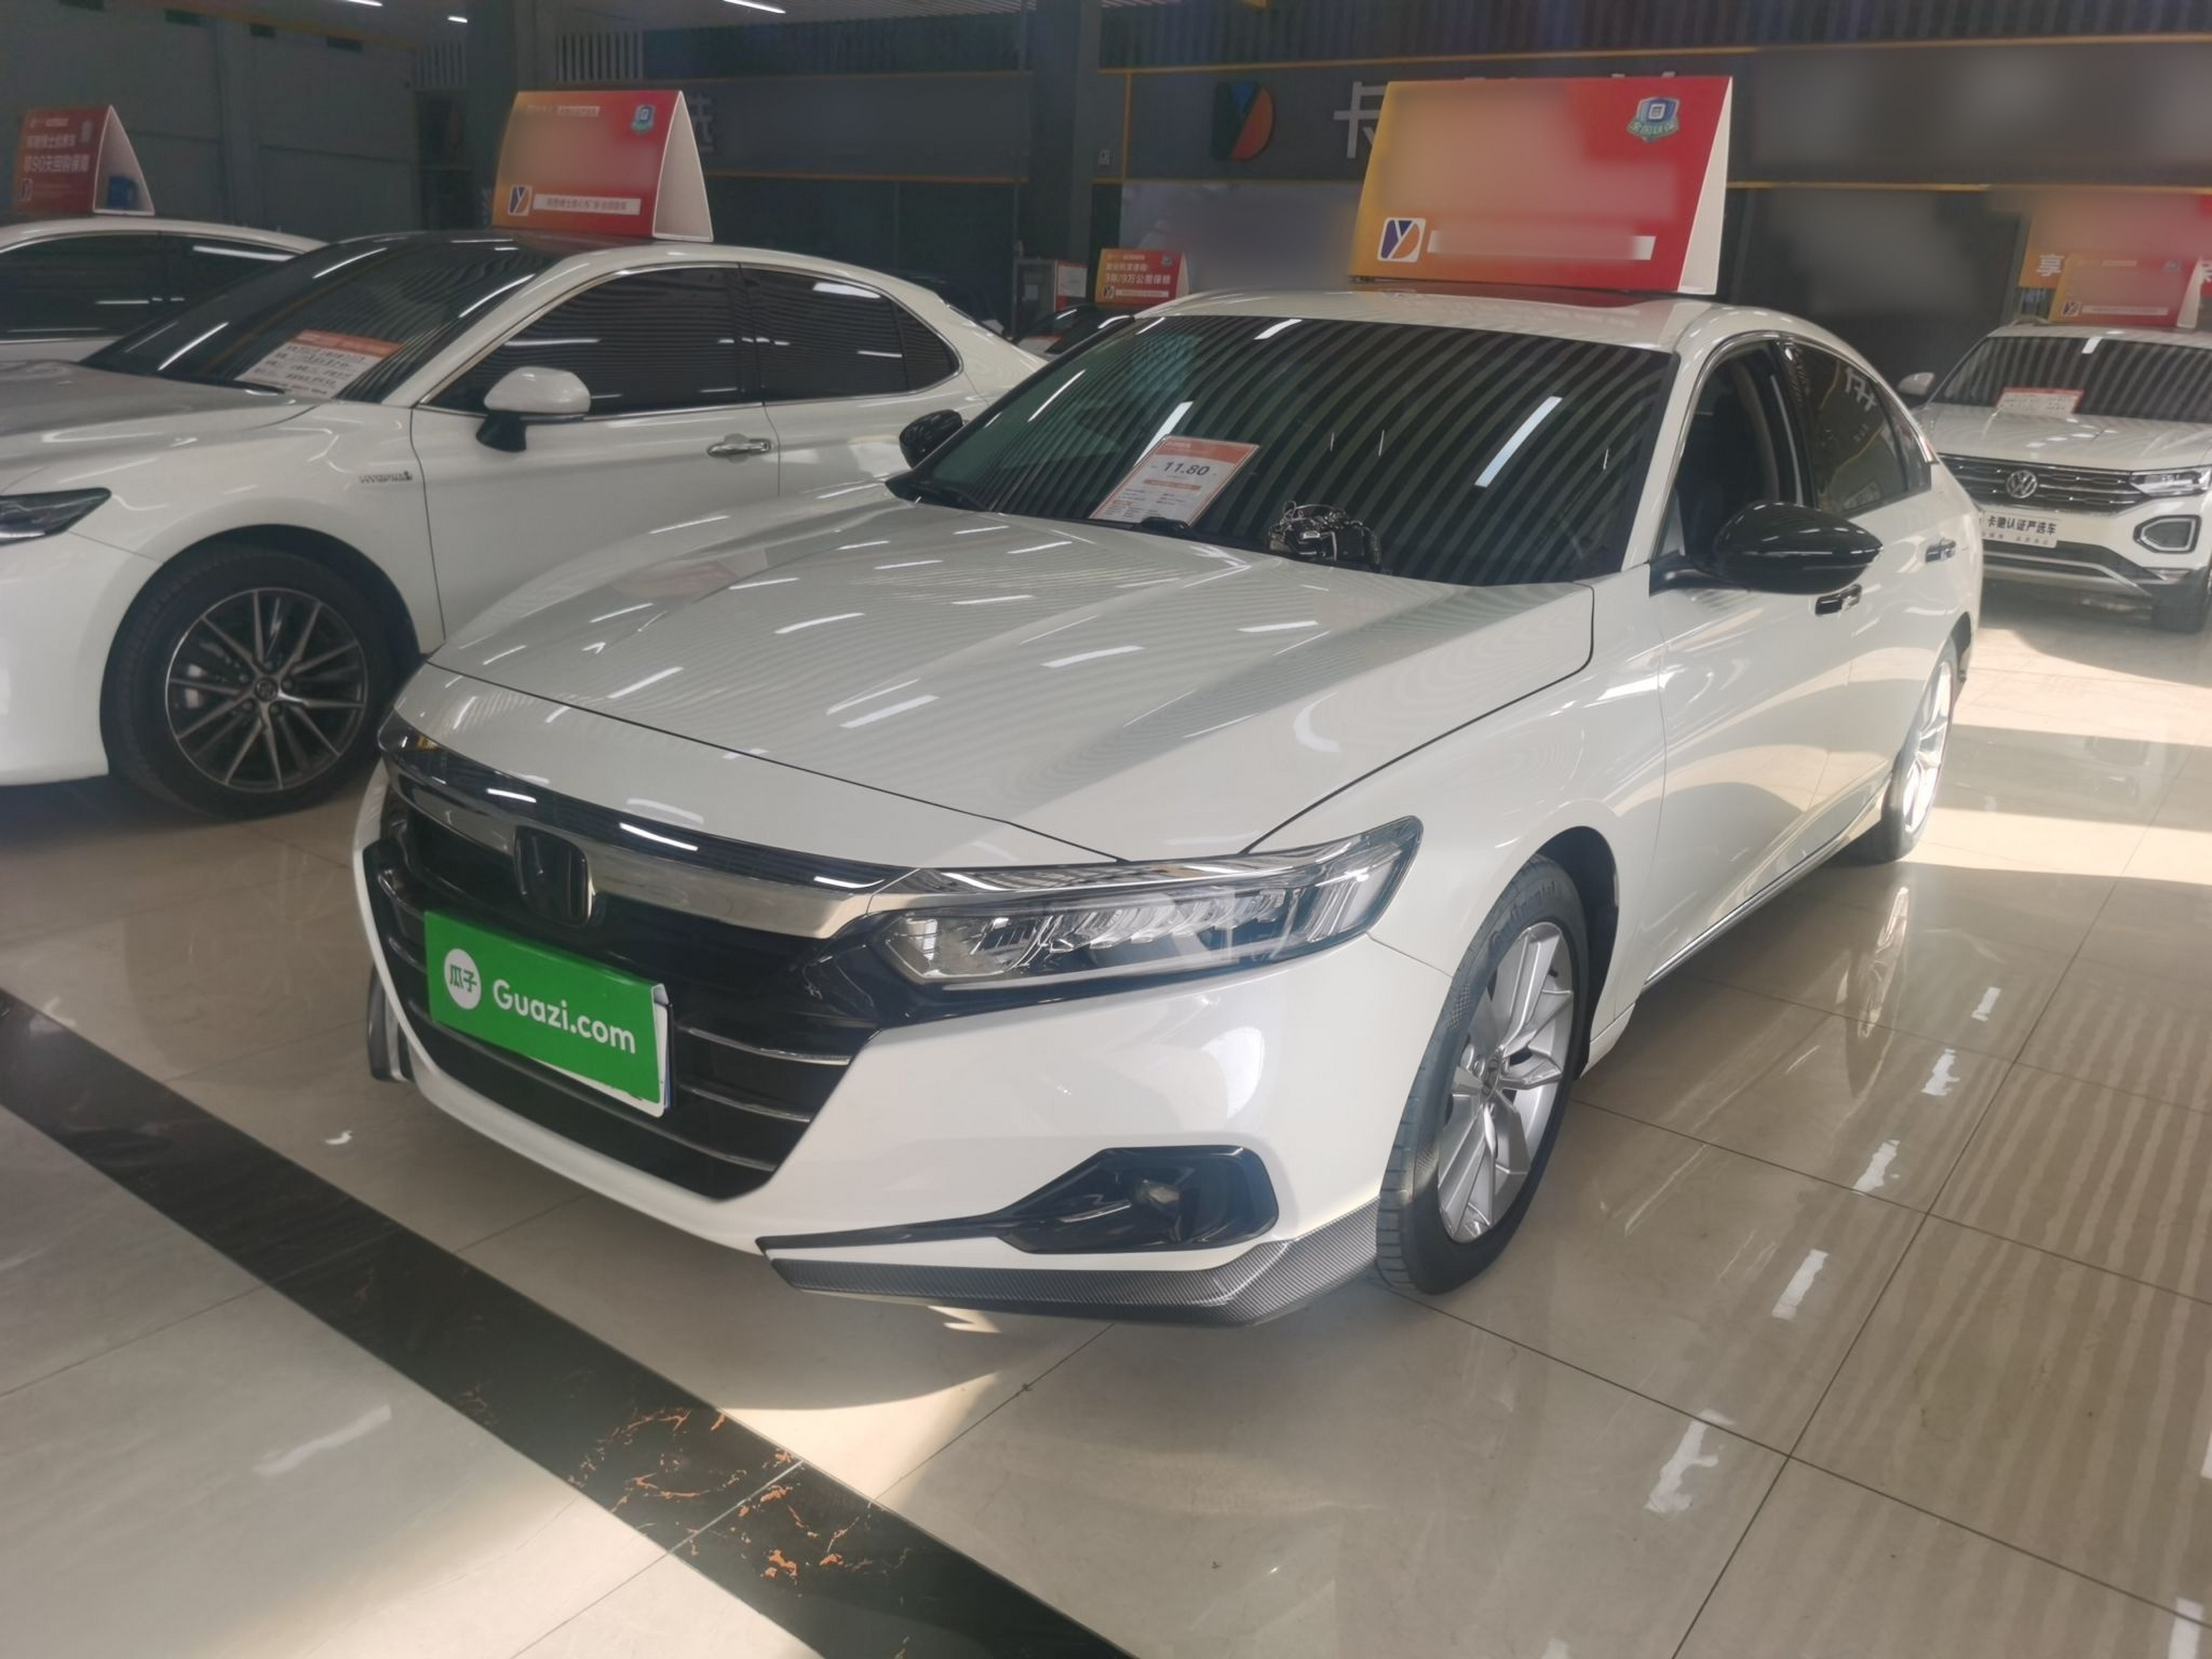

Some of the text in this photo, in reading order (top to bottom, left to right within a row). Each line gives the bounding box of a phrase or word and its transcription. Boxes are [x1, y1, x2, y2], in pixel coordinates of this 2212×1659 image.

[1163, 461, 1210, 476] 11.80
[449, 964, 477, 994] 瓜子
[493, 979, 635, 1054] Guazi.com
